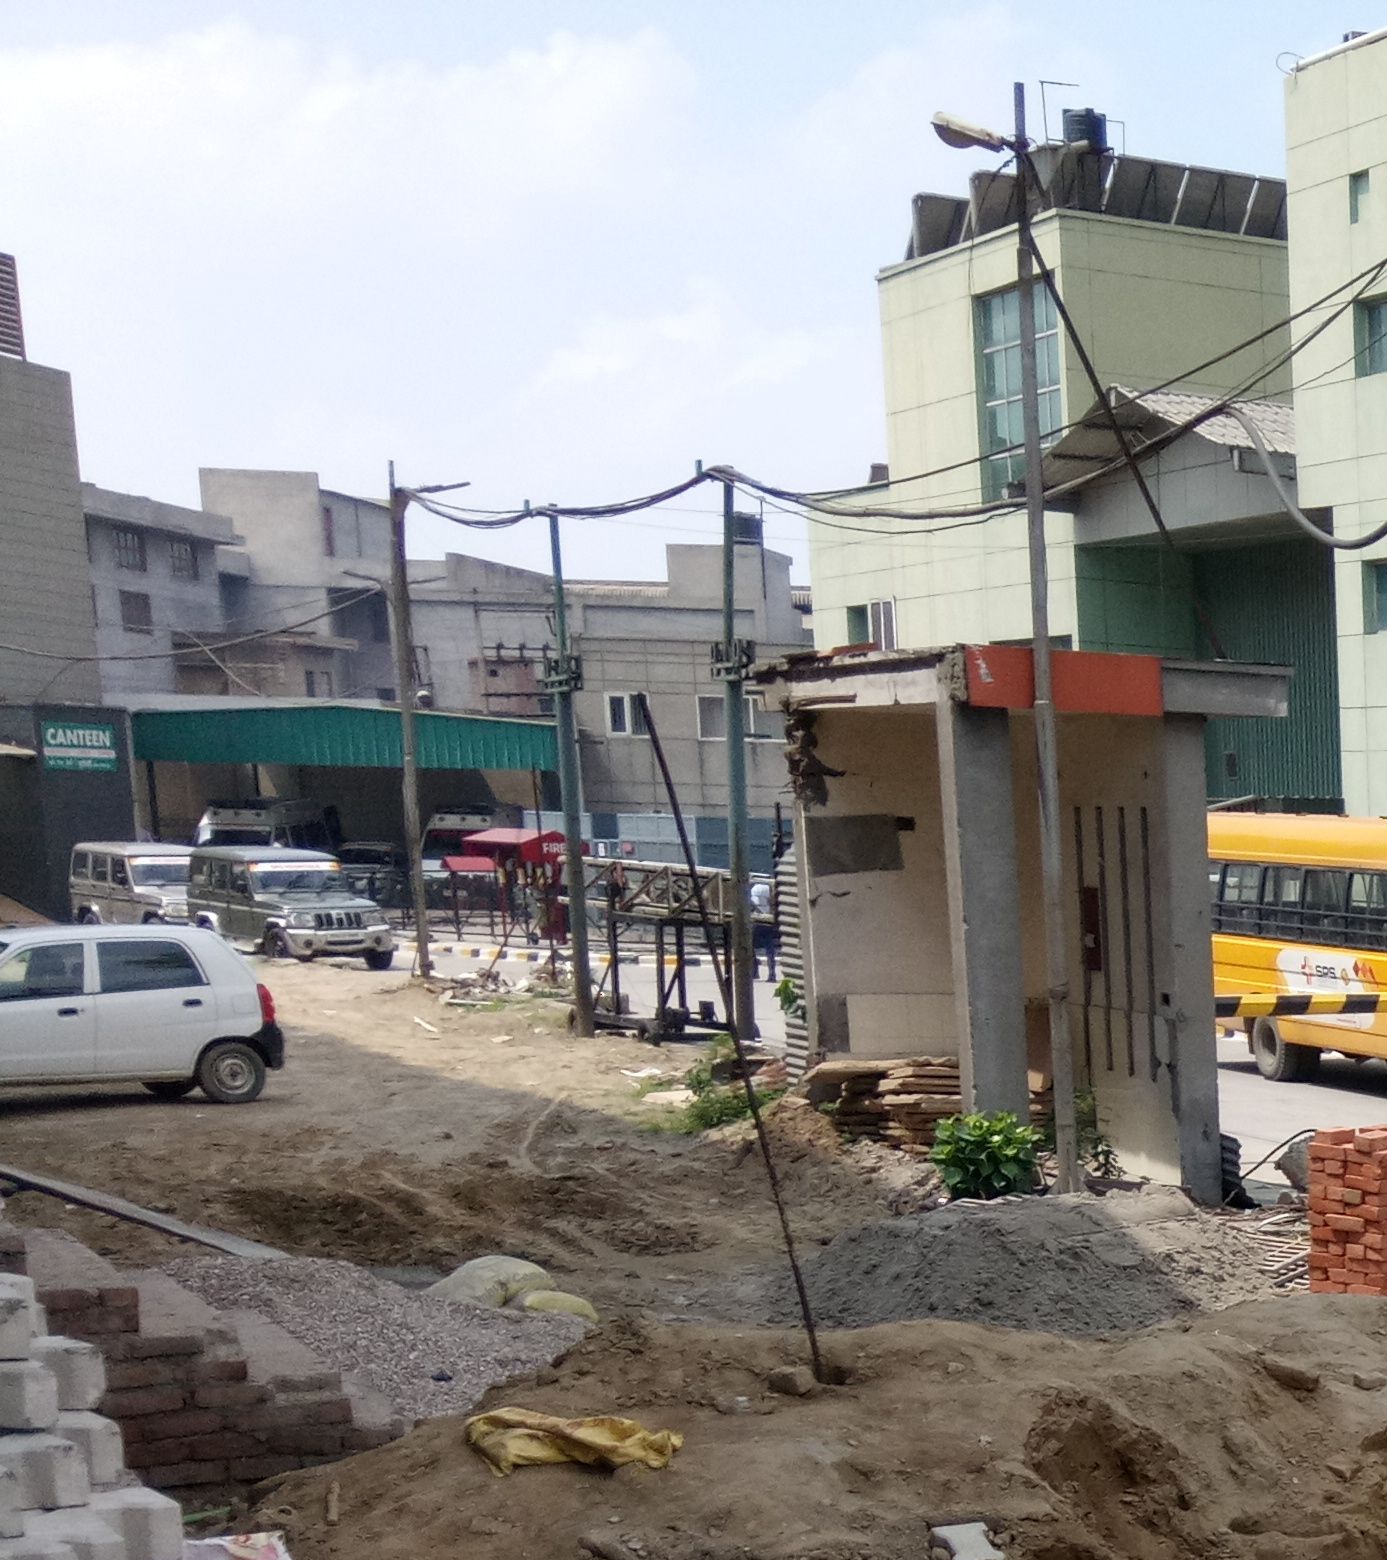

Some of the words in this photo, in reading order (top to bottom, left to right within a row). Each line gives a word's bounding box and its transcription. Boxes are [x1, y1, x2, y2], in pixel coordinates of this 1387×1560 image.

[46, 728, 110, 747] CANTEEN
[542, 842, 567, 854] FIRE
[1315, 965, 1337, 979] SPS
